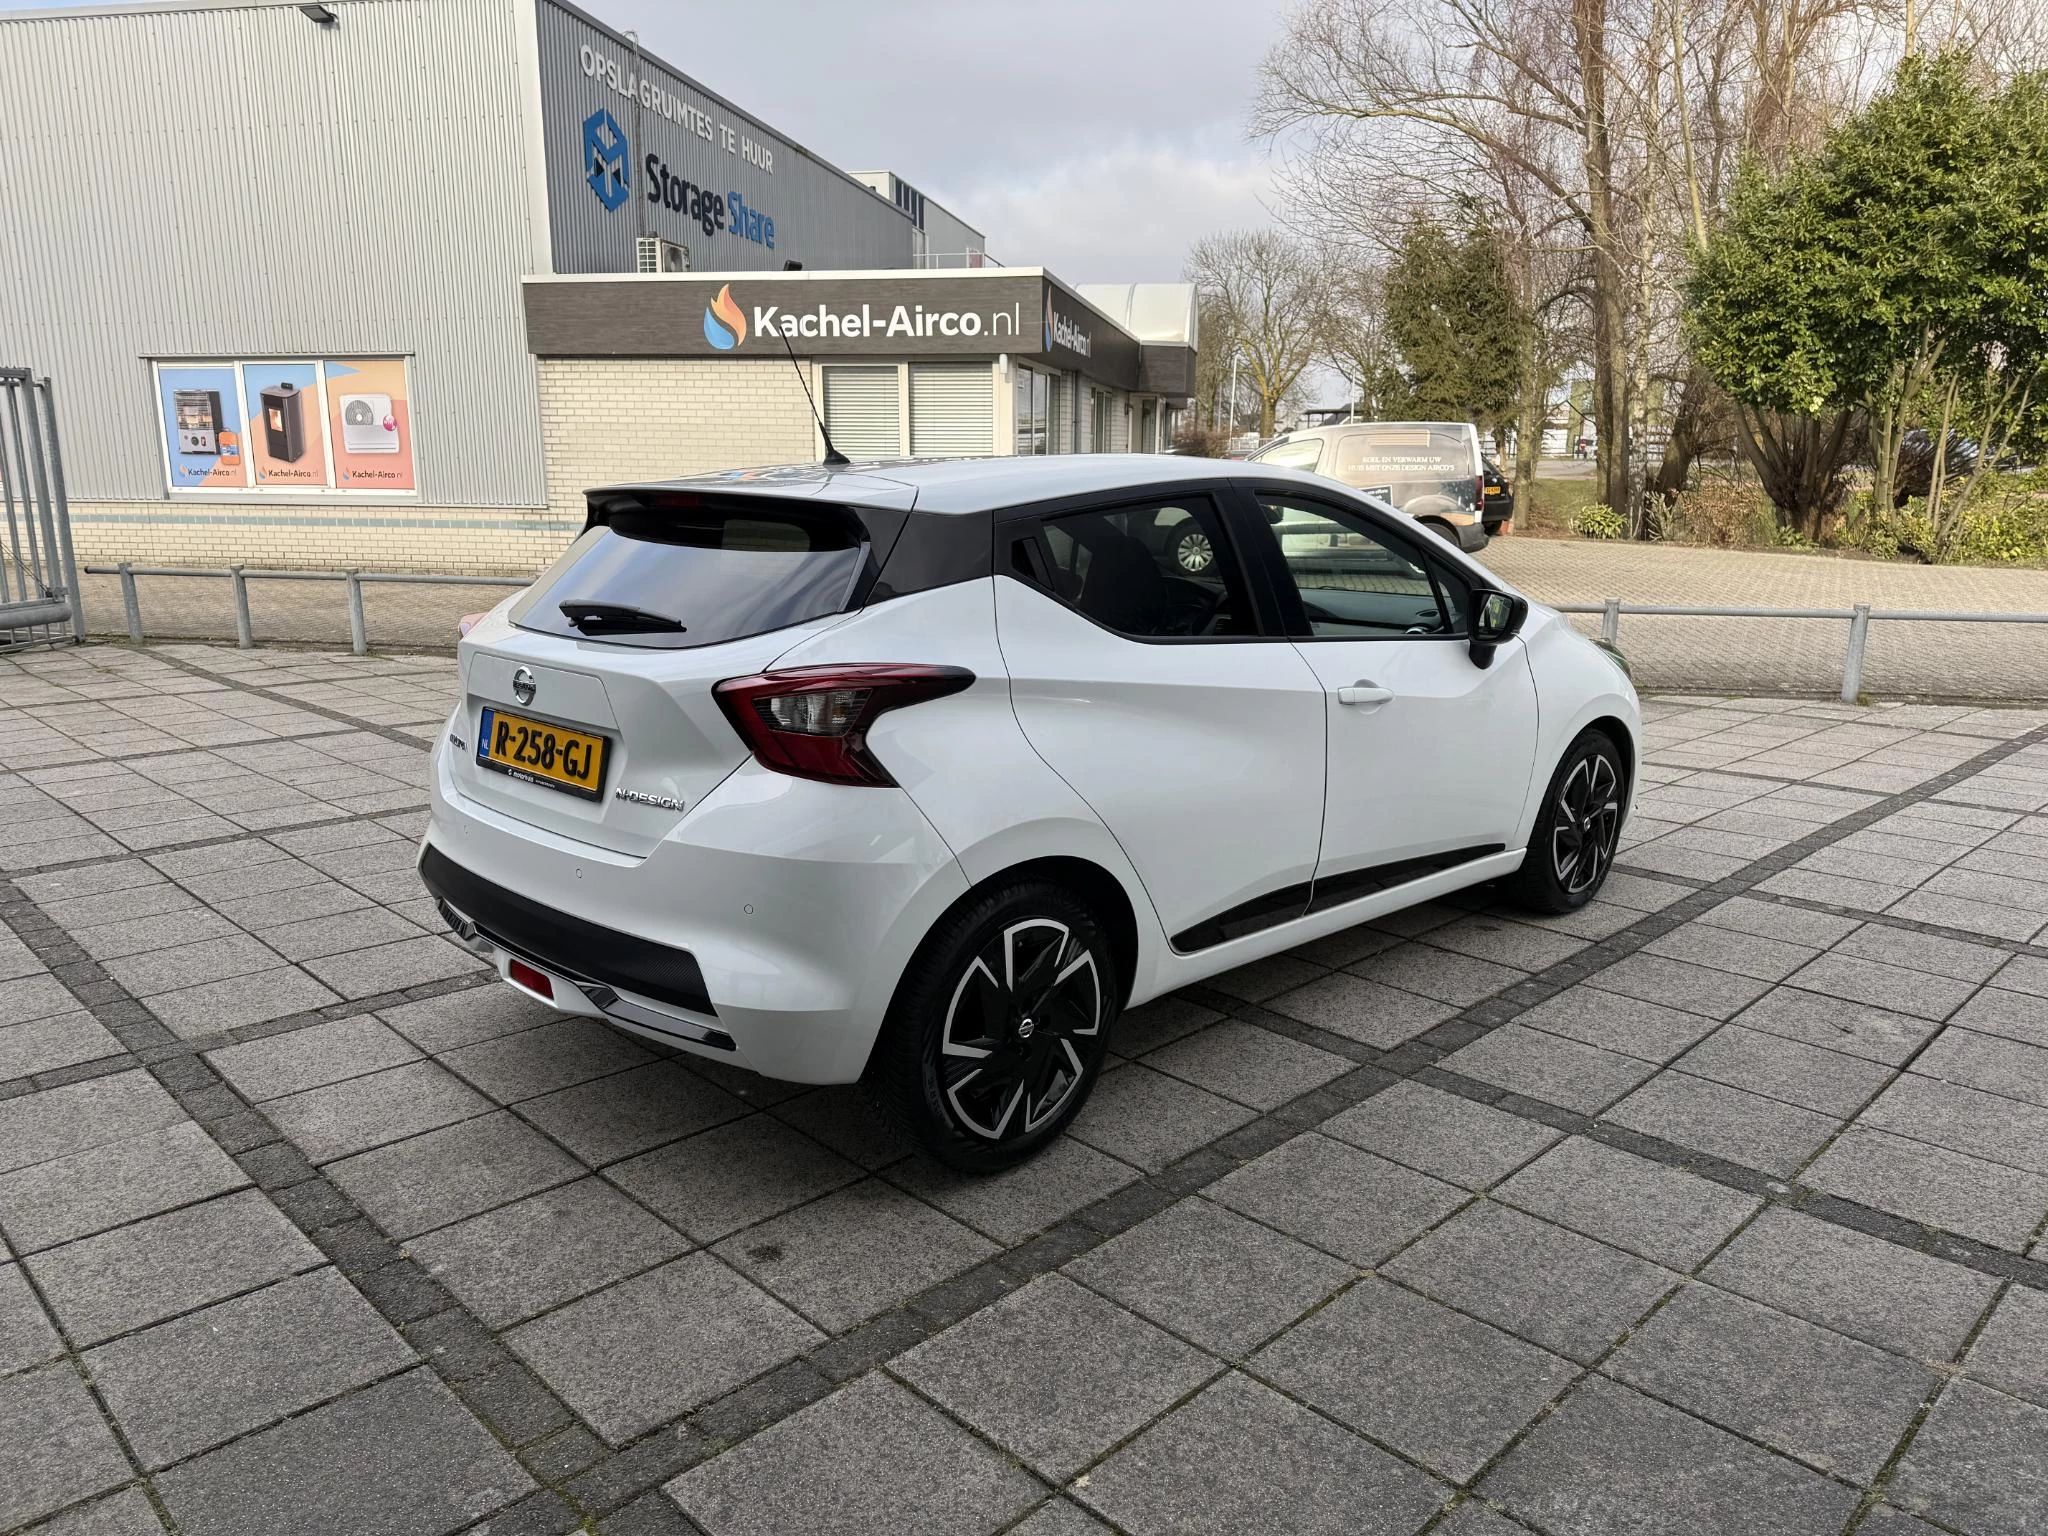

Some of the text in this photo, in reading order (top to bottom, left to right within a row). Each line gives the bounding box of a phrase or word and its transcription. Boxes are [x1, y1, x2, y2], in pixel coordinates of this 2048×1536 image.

[580, 44, 773, 175] OPSLAGRUIMTES TE HUUR
[645, 153, 775, 249] Storage Share
[753, 302, 1020, 338] Kachel-Airco.nl
[481, 738, 489, 750] NL
[495, 720, 592, 780] R-258-GJ
[615, 787, 685, 811] N-DESIGN
